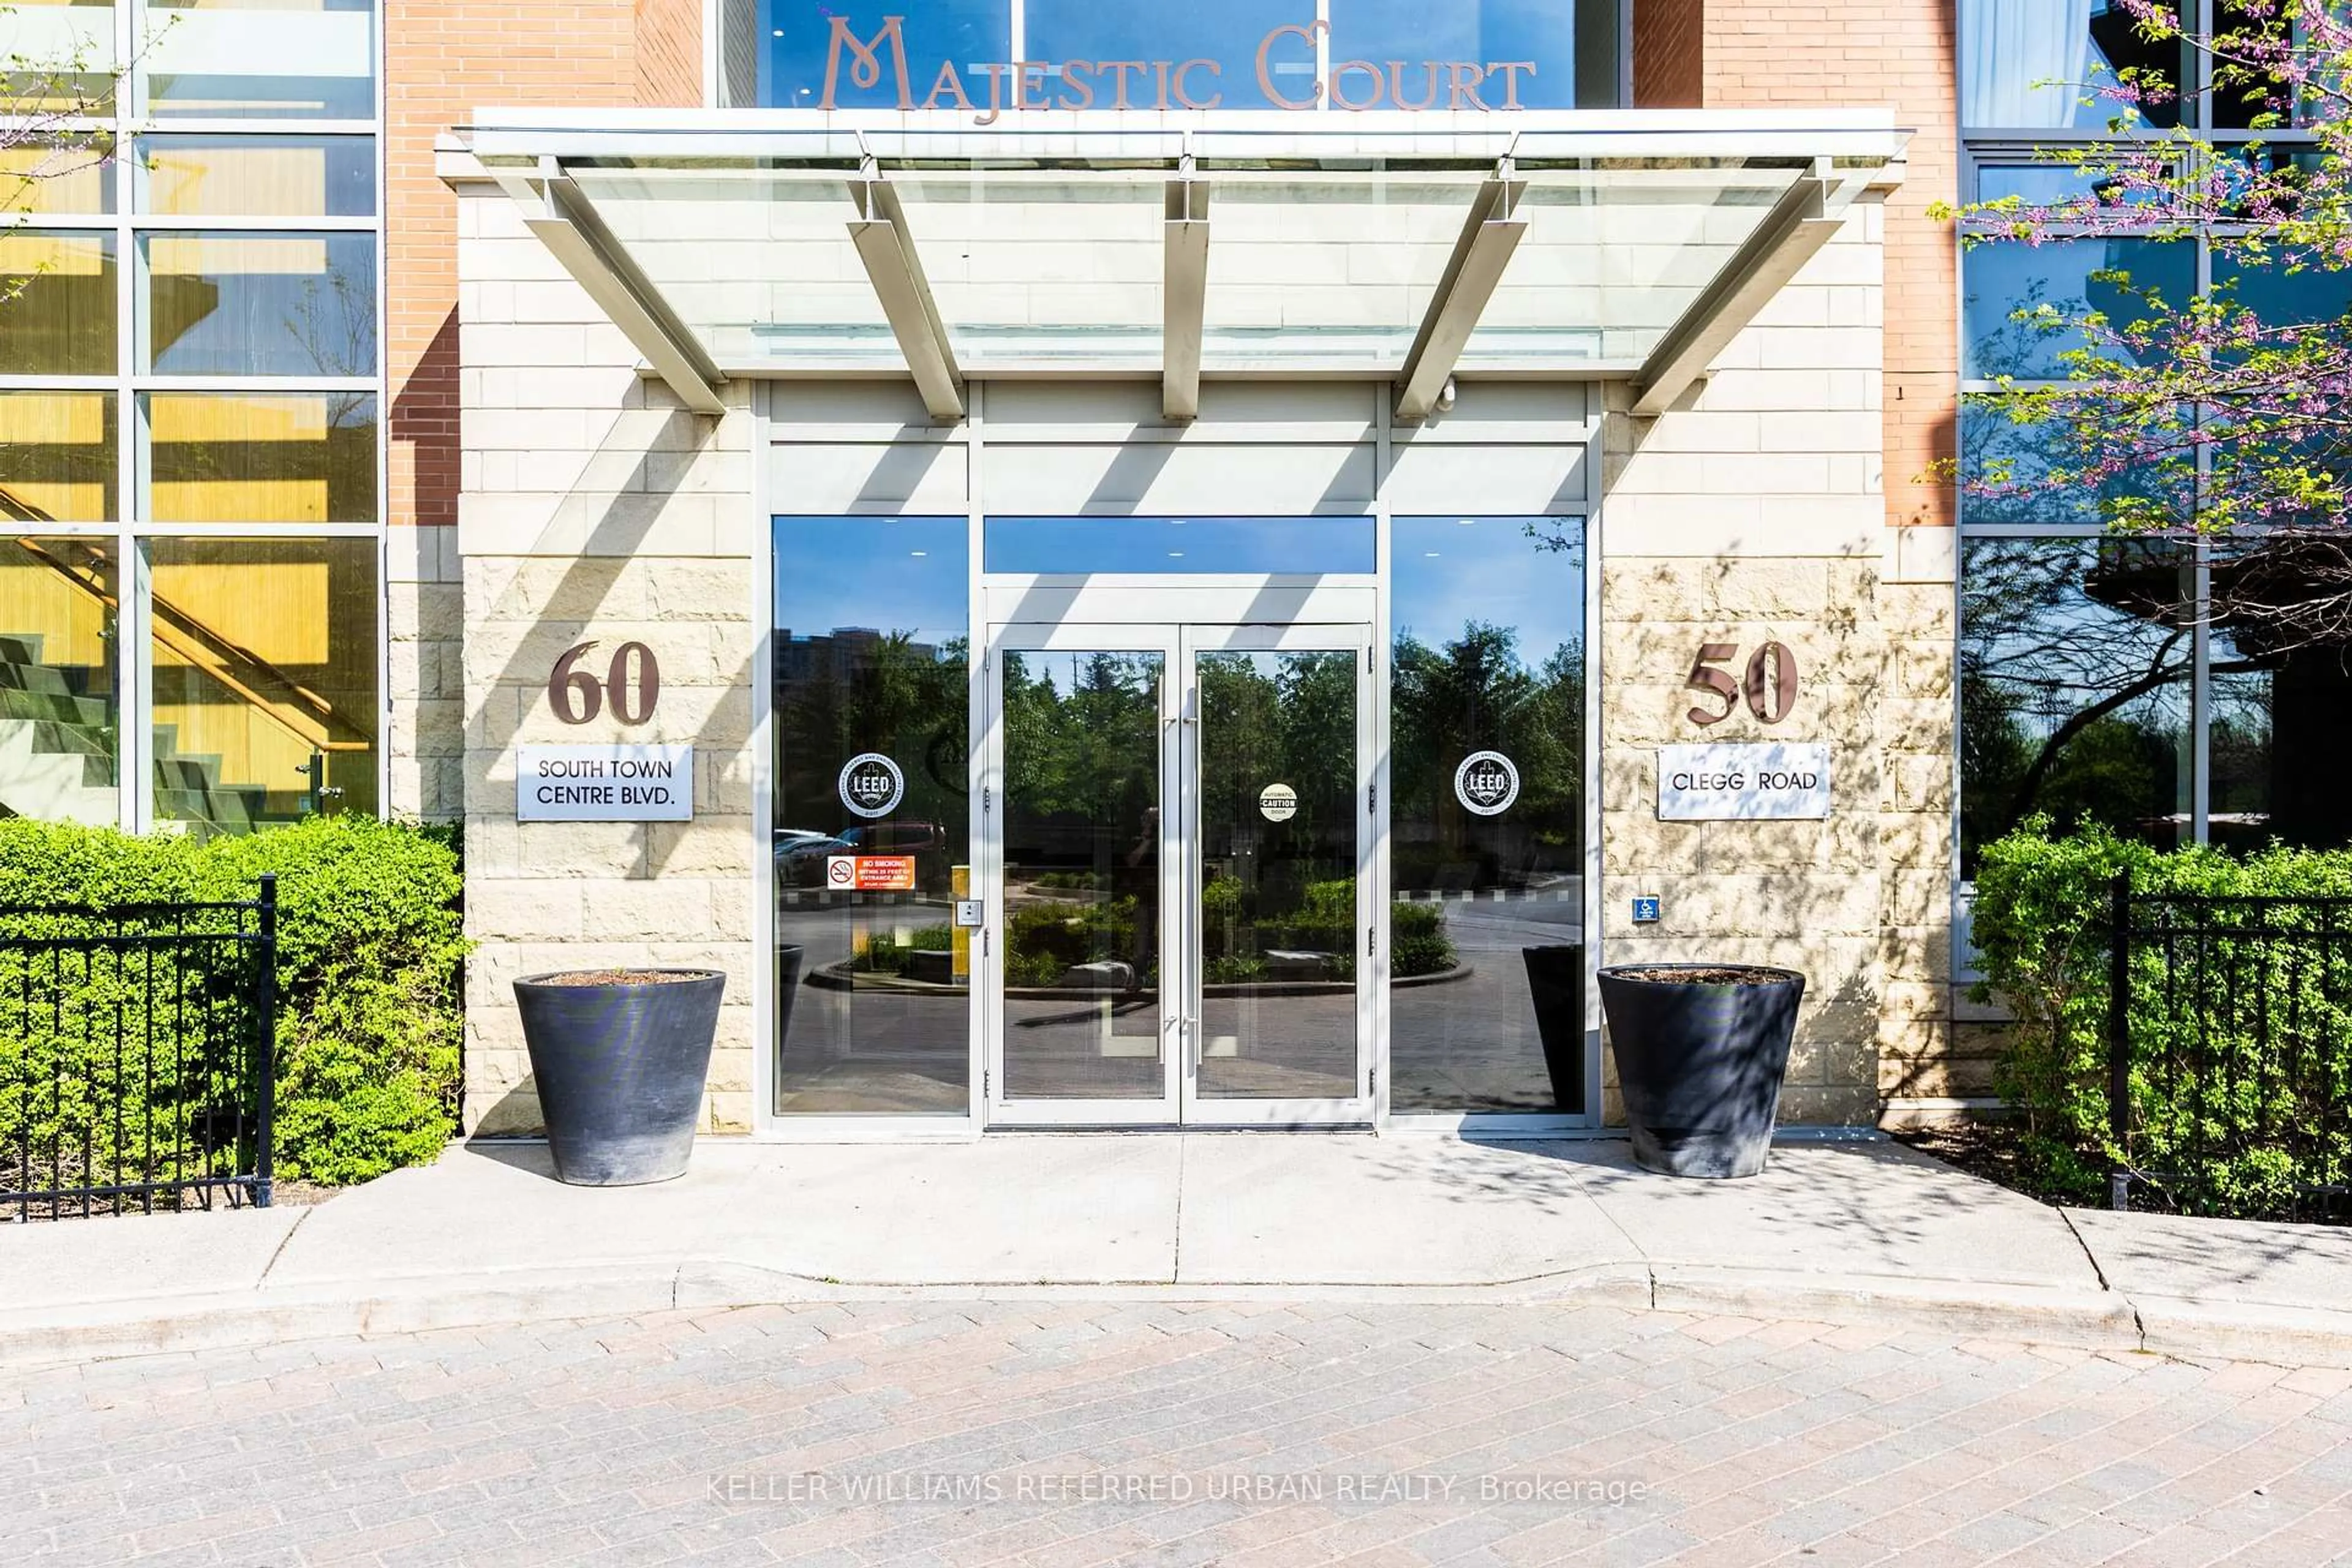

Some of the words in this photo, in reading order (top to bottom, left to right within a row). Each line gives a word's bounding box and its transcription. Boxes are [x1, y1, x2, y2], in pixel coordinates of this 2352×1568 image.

[817, 16, 1222, 124] MAJESTIC
[1256, 19, 1537, 111] COURT
[548, 640, 660, 726] 60
[1686, 641, 1798, 725] 50
[538, 760, 603, 778] SOUTH
[611, 760, 672, 778] TOWN
[854, 776, 889, 792] LEED
[1470, 774, 1504, 790] LEED
[1673, 773, 1745, 790] CLEGG
[1758, 772, 1817, 790] ROAD
[537, 786, 613, 804] CENTRE
[621, 786, 675, 804] BLVD.
